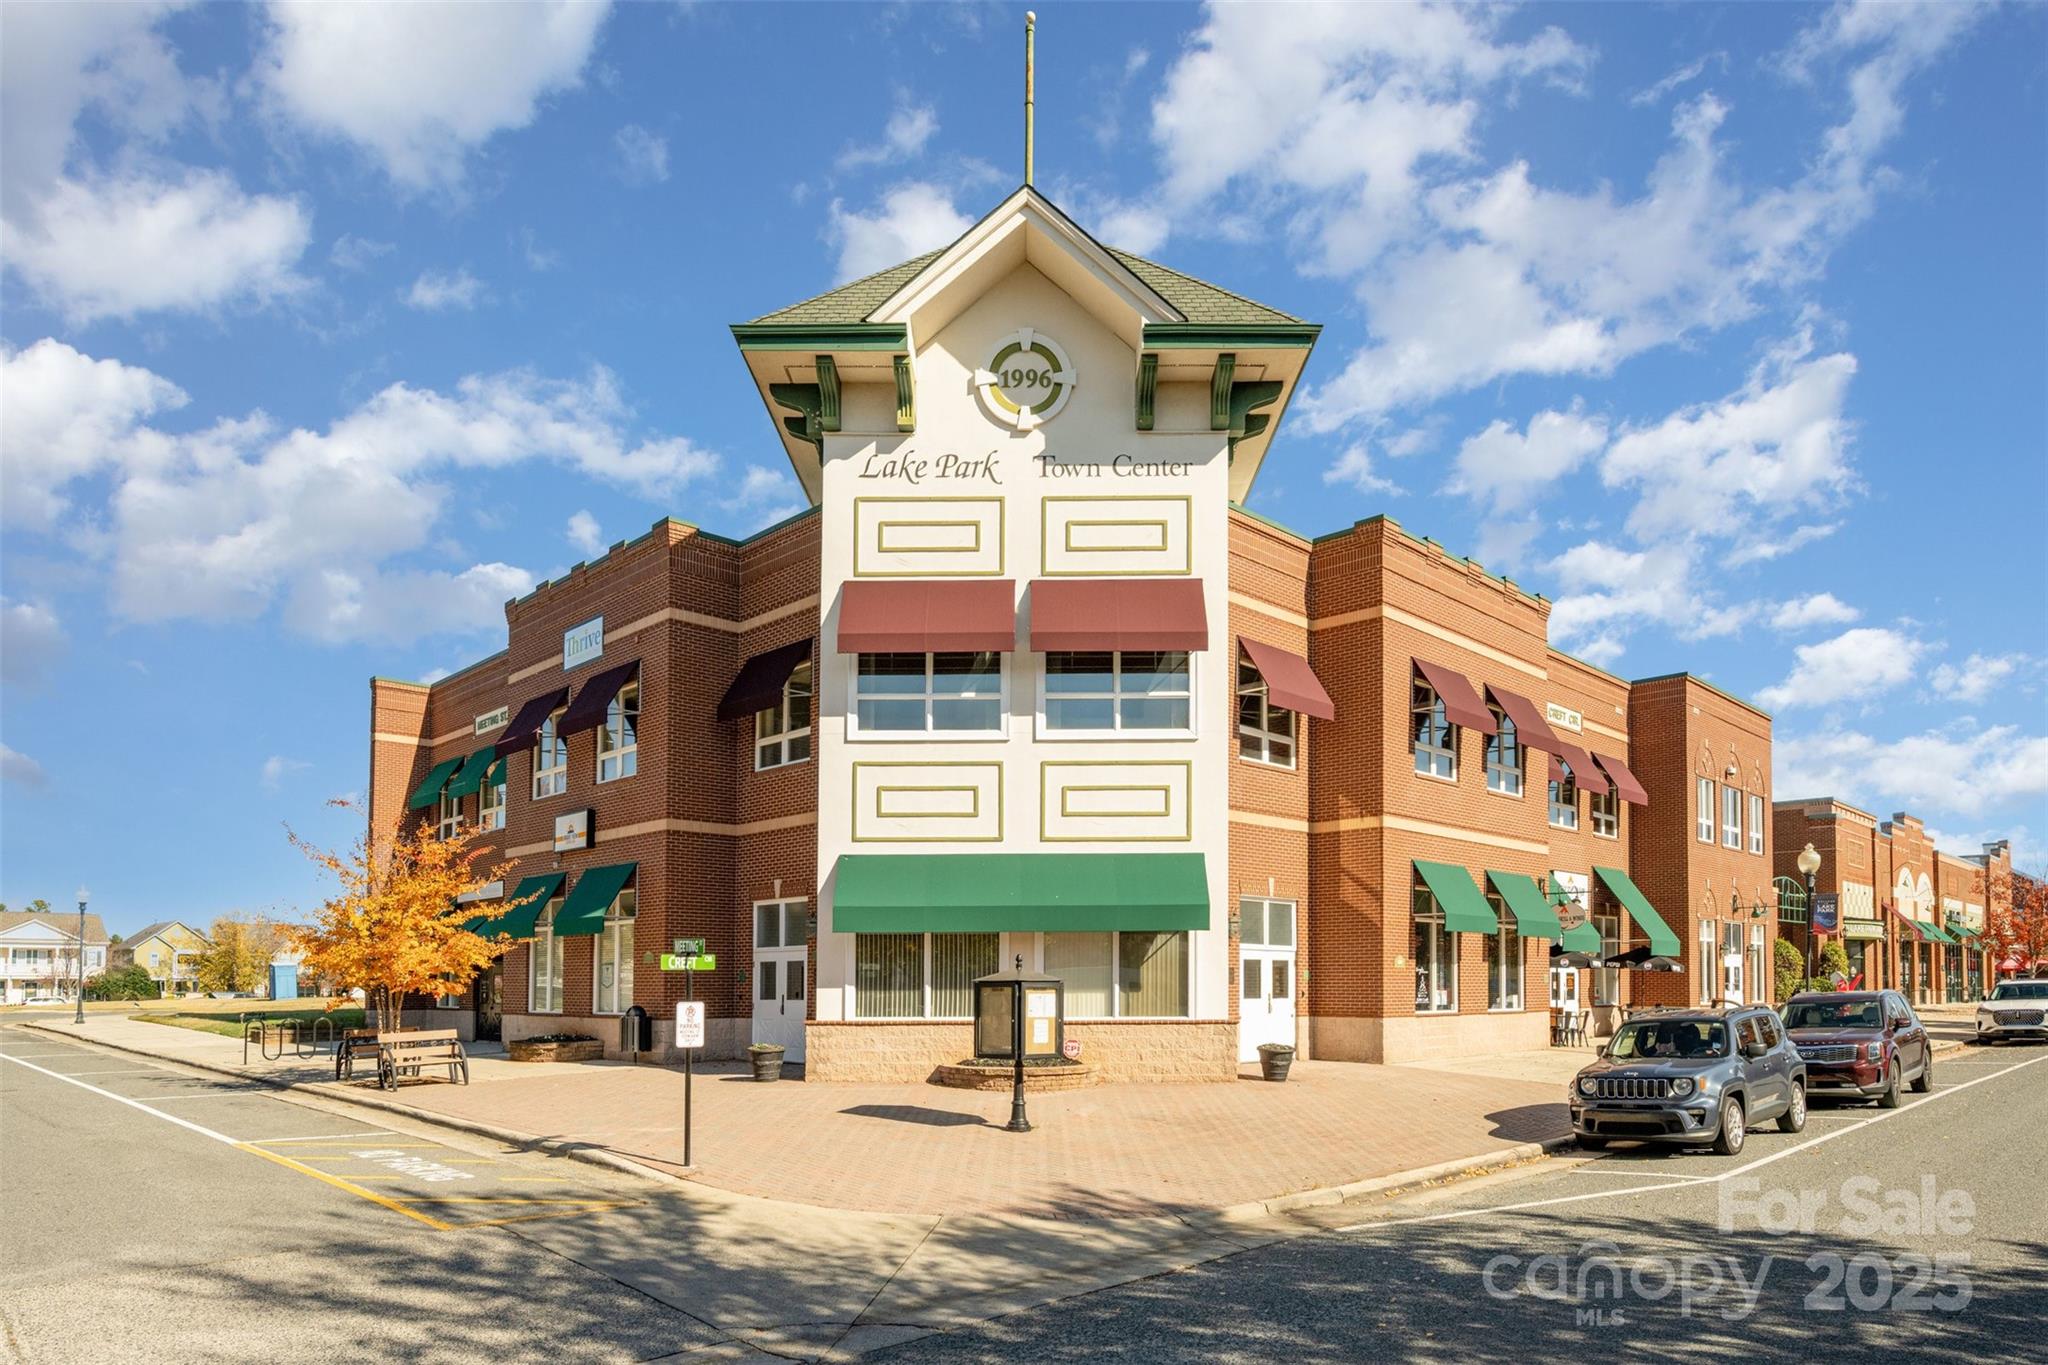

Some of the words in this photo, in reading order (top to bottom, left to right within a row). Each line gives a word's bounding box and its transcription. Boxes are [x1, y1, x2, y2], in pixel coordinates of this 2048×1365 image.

[1001, 368, 1052, 388] 1996
[859, 449, 927, 484] Lake
[935, 449, 1003, 485] Park
[1032, 454, 1102, 478] Town
[1112, 453, 1195, 478] Center
[567, 629, 601, 657] Thrive
[675, 940, 699, 952] MEETING
